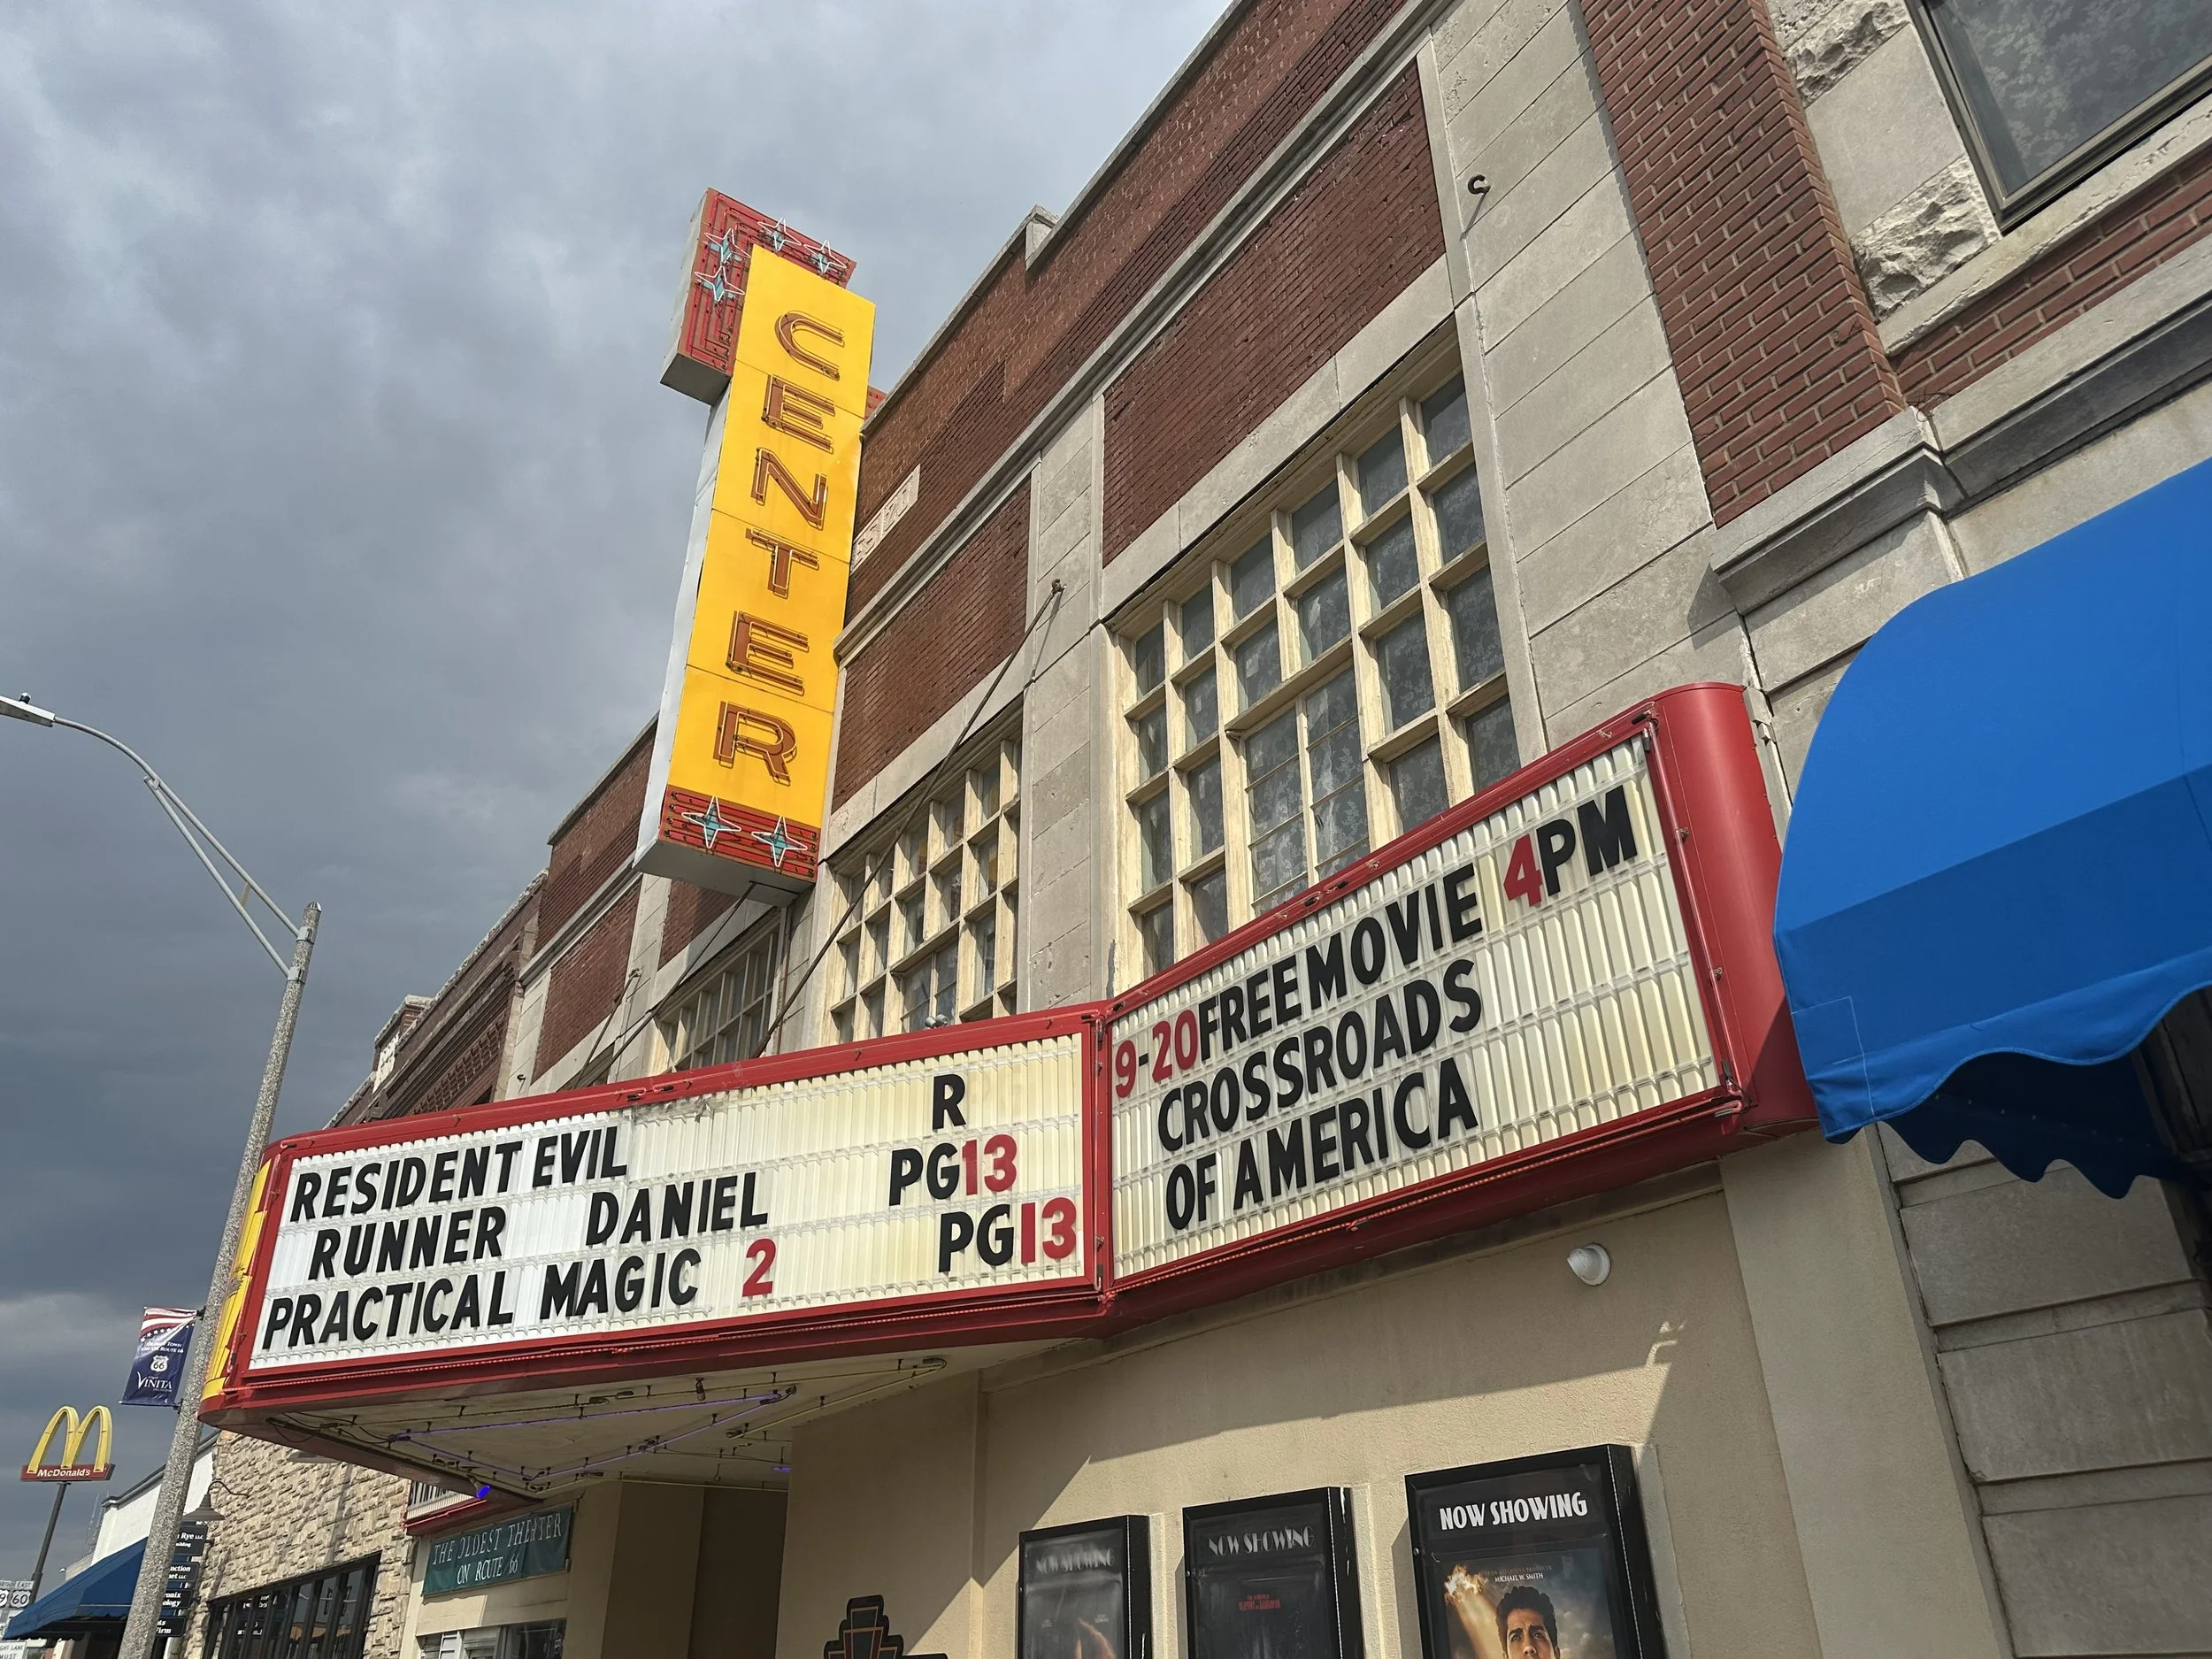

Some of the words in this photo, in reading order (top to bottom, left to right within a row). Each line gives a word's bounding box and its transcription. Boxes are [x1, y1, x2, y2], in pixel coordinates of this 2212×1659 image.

[711, 310, 847, 787] CENTER
[1502, 785, 1639, 908] 4PM
[1157, 959, 1483, 1152] CROSSROADS
[289, 1141, 523, 1223] RESIDENT
[531, 1125, 627, 1188] EVIL
[932, 1073, 967, 1131] R
[1165, 1154, 1217, 1231] OF
[1233, 1056, 1479, 1211] AMERICA
[308, 1206, 507, 1280] RUNNER
[585, 1171, 769, 1248] DANIEL
[889, 1133, 1018, 1207] PG13
[261, 1271, 514, 1350] PRACTICAL
[538, 1248, 702, 1321] MAGIC
[741, 1237, 777, 1298] 2
[938, 1196, 1078, 1273] PG13
[136, 1371, 173, 1389] VINITA
[37, 1468, 91, 1477] McDonald's
[1439, 1502, 1486, 1531] NOW
[1489, 1491, 1589, 1525] SHOWING
[432, 1540, 455, 1565] THE
[457, 1527, 503, 1560] OLDEST
[507, 1512, 562, 1548] THEATER
[457, 1563, 471, 1585] ON
[475, 1556, 503, 1581] ROUTE
[509, 1553, 519, 1574] 66
[1209, 1534, 1239, 1555] NOW
[1243, 1525, 1315, 1555] SHOWING
[12, 1594, 28, 1605] 60
